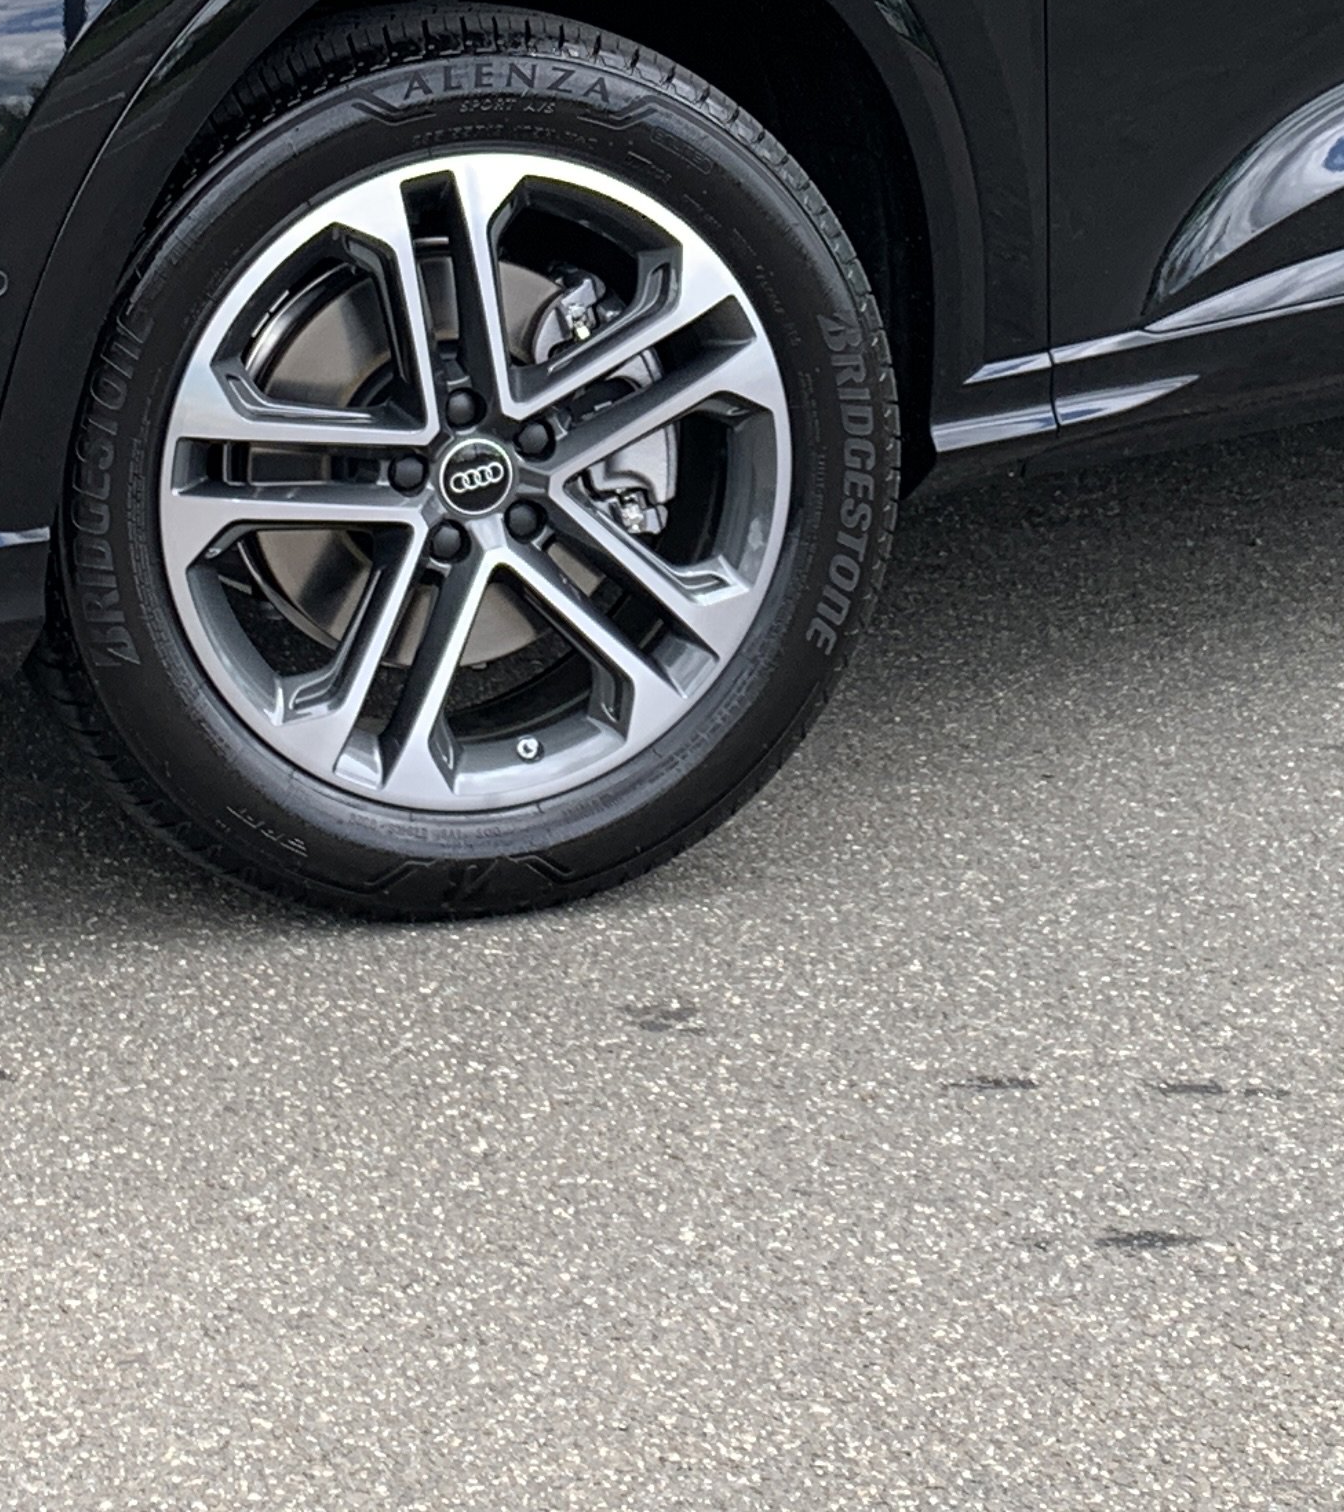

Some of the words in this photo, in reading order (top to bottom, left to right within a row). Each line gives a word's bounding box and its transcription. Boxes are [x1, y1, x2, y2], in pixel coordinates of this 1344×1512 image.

[403, 63, 610, 103] ALENZA
[459, 97, 518, 113] SPORT
[71, 308, 154, 666] BRIDGESTONE
[806, 312, 876, 656] BRIDGESTONE
